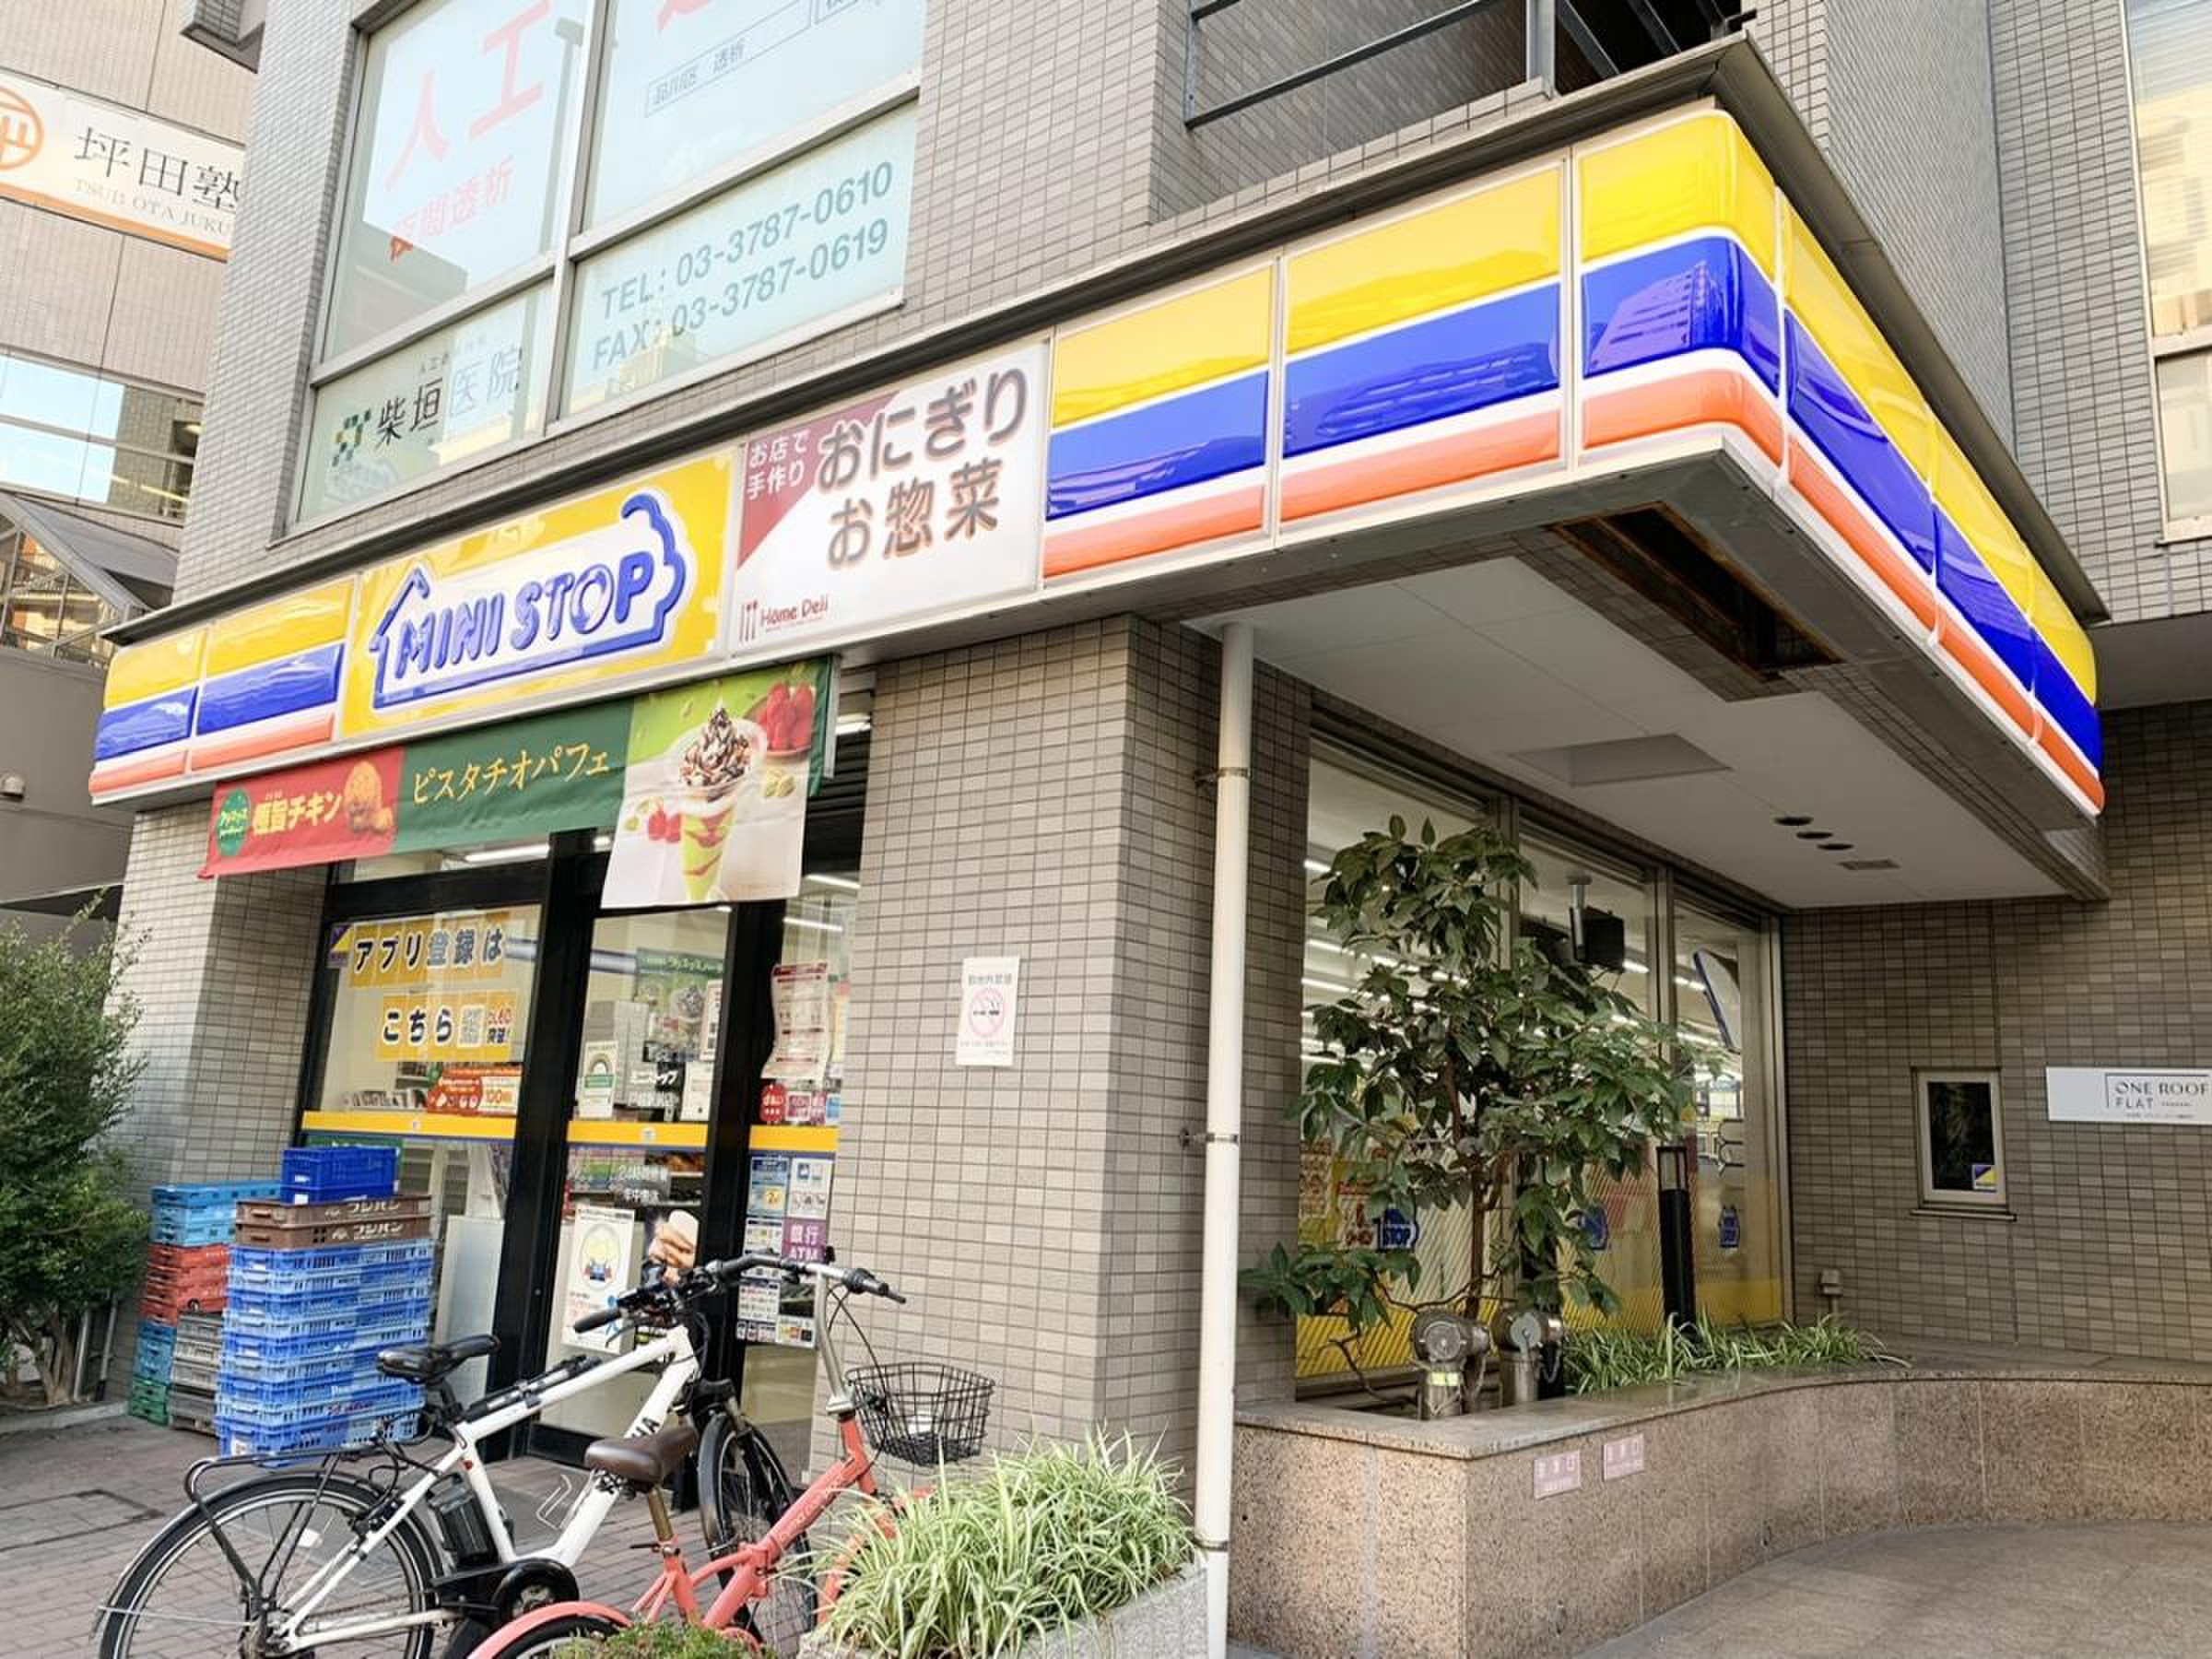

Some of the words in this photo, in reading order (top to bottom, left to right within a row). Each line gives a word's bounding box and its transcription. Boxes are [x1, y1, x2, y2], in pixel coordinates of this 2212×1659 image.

[74, 127, 240, 212] 坪田塾
[601, 266, 668, 319] TEL:
[678, 161, 892, 288] 03-3787-0610
[593, 317, 665, 371] FAX:
[673, 218, 889, 337] 03-3787-0619
[375, 344, 524, 449] 柴垣医院
[818, 369, 1029, 492] おにぎり
[747, 463, 805, 500] 手作り
[749, 430, 809, 467] お店で
[828, 457, 1005, 571] お惣菜
[394, 580, 503, 679] MINI
[510, 549, 656, 651] STOP
[760, 606, 797, 627] Home
[802, 594, 829, 618] Deli
[412, 741, 611, 806] ピスタチオパフェ
[382, 1007, 453, 1043] こちら
[2115, 1082, 2153, 1095] ONE
